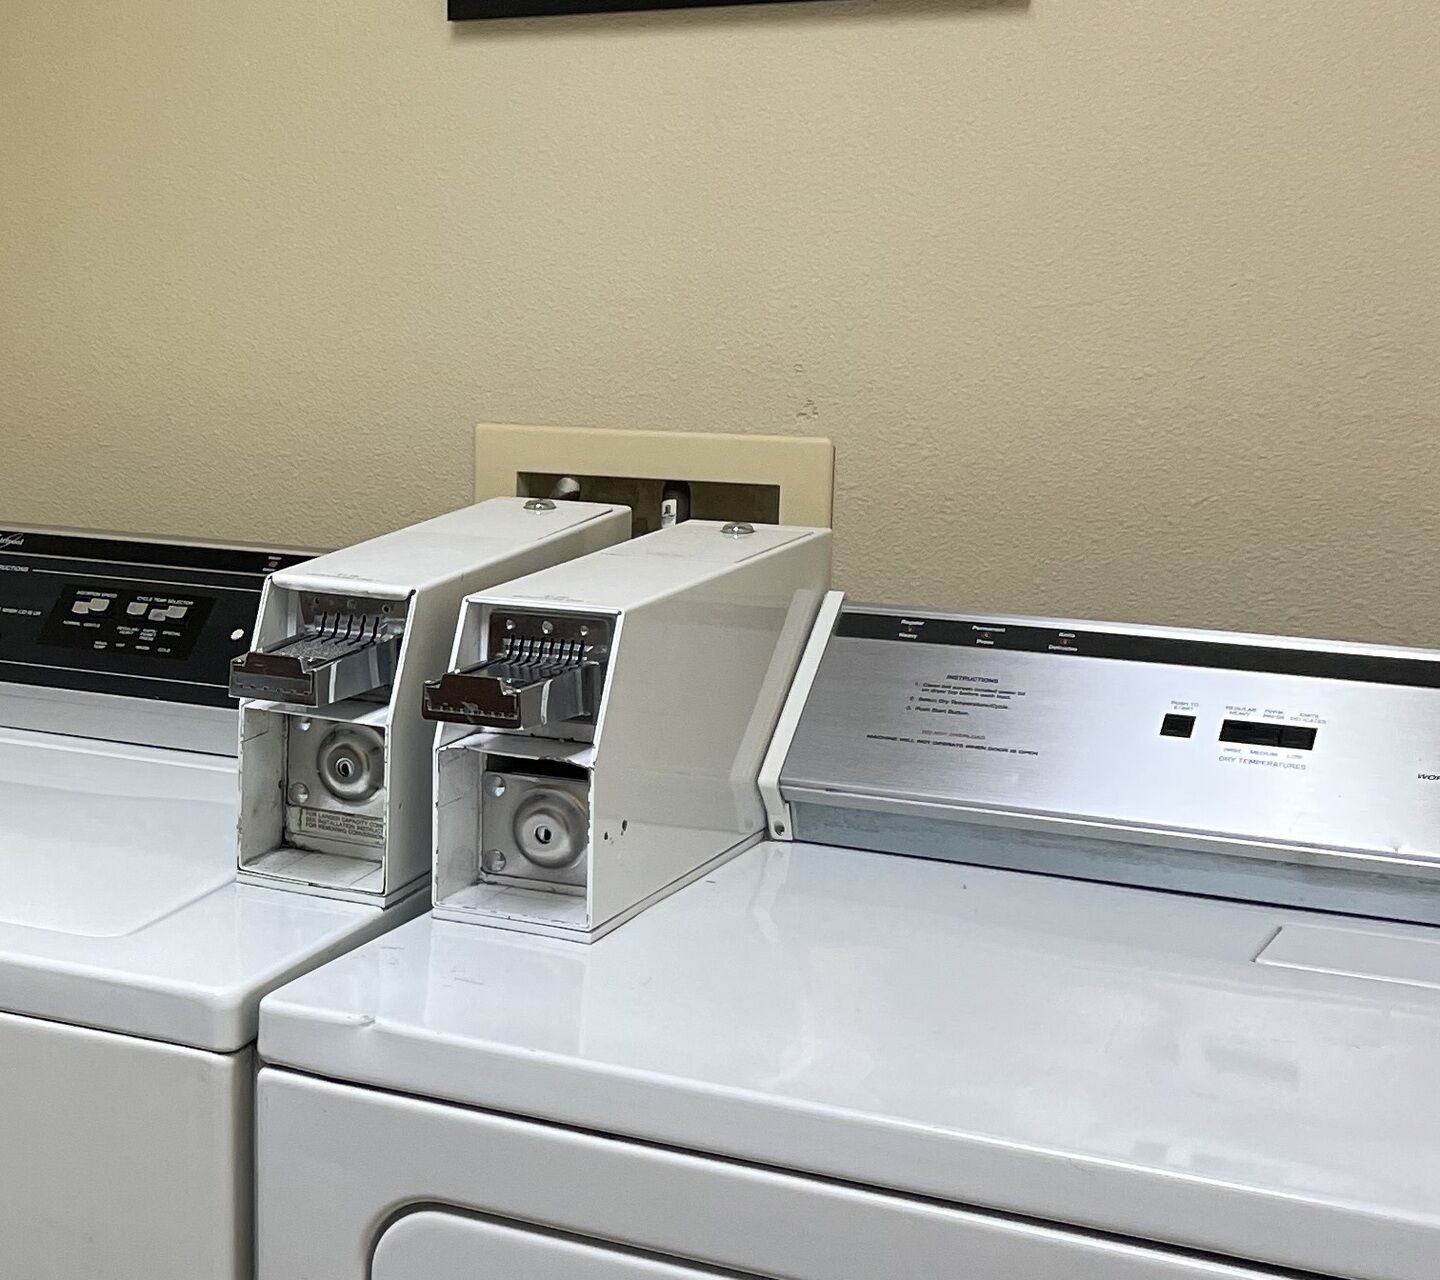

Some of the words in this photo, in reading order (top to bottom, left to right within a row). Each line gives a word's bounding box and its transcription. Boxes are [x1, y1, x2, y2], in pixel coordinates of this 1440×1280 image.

[946, 674, 999, 684] INSTRUCTIONS
[1218, 755, 1237, 764] DRY
[1238, 757, 1308, 771] TEMPERATURES
[318, 823, 348, 834] REMOVING
